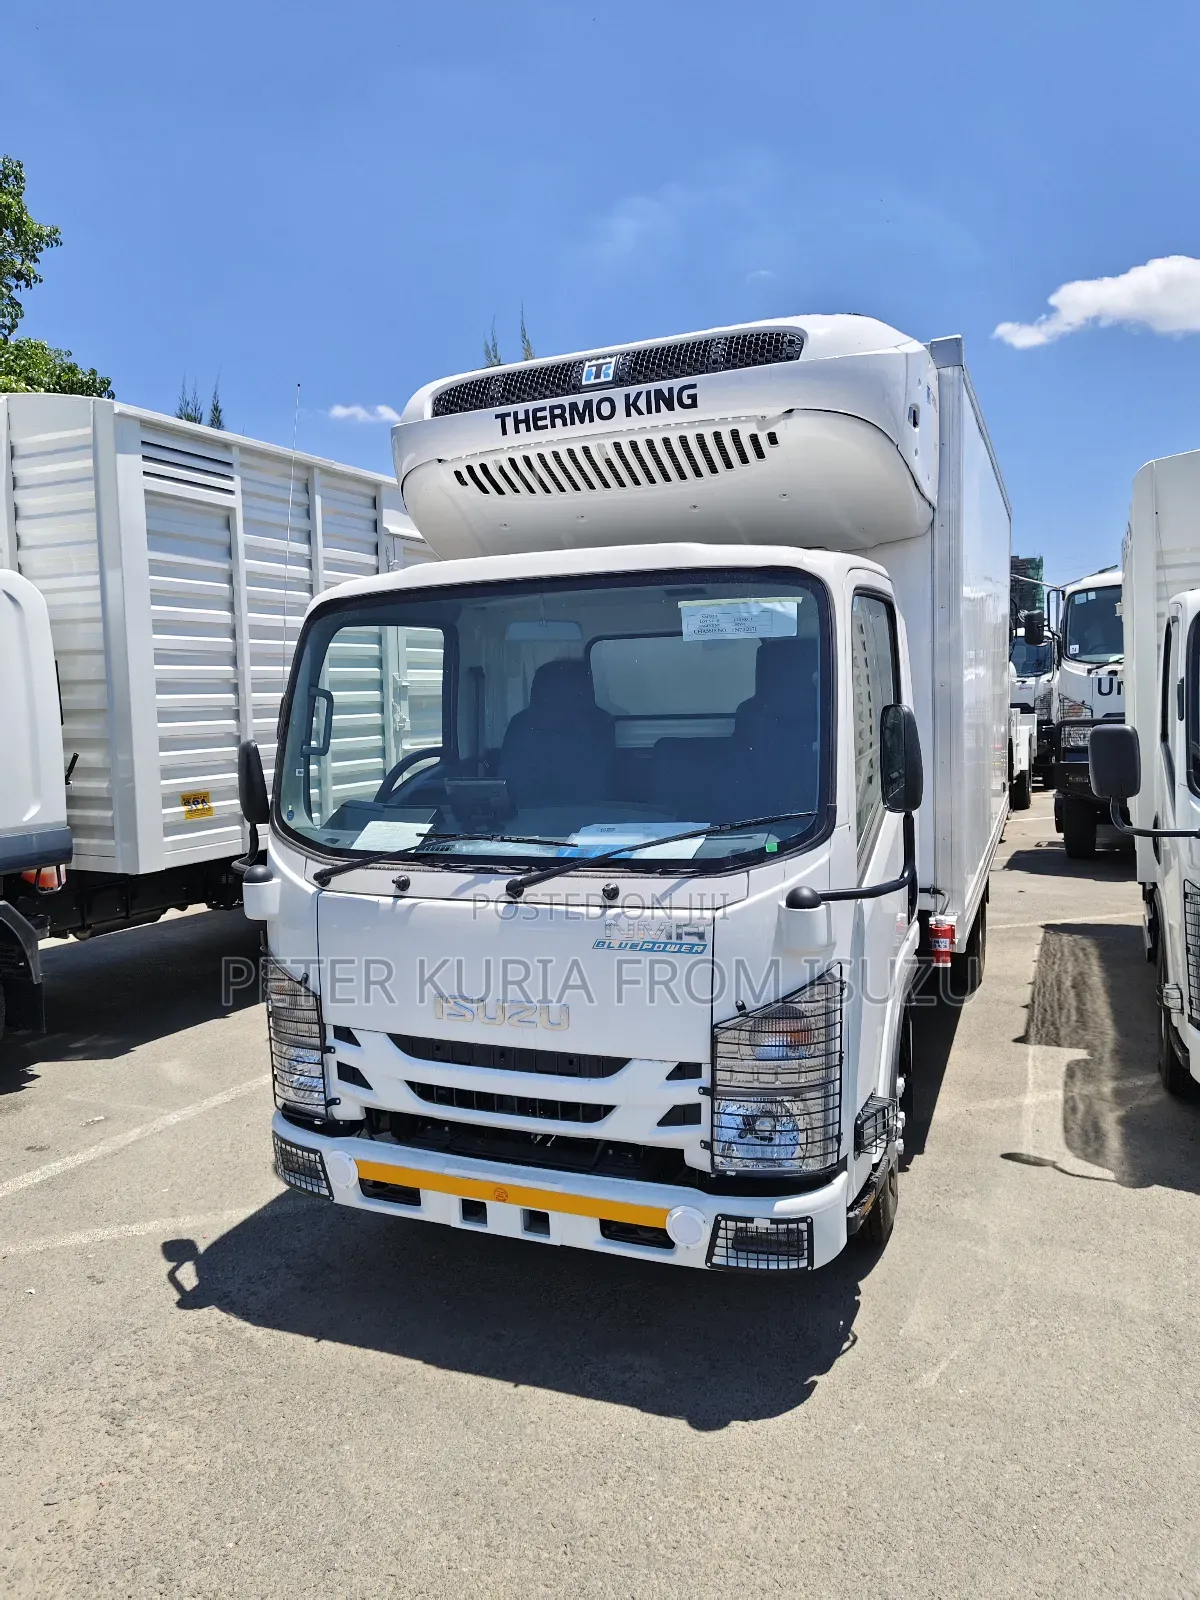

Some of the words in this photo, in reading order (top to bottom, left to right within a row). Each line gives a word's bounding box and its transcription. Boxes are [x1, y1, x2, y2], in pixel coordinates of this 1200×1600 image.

[494, 396, 617, 436] THERMO
[624, 383, 698, 418] KING
[433, 994, 570, 1031] ISUZU
